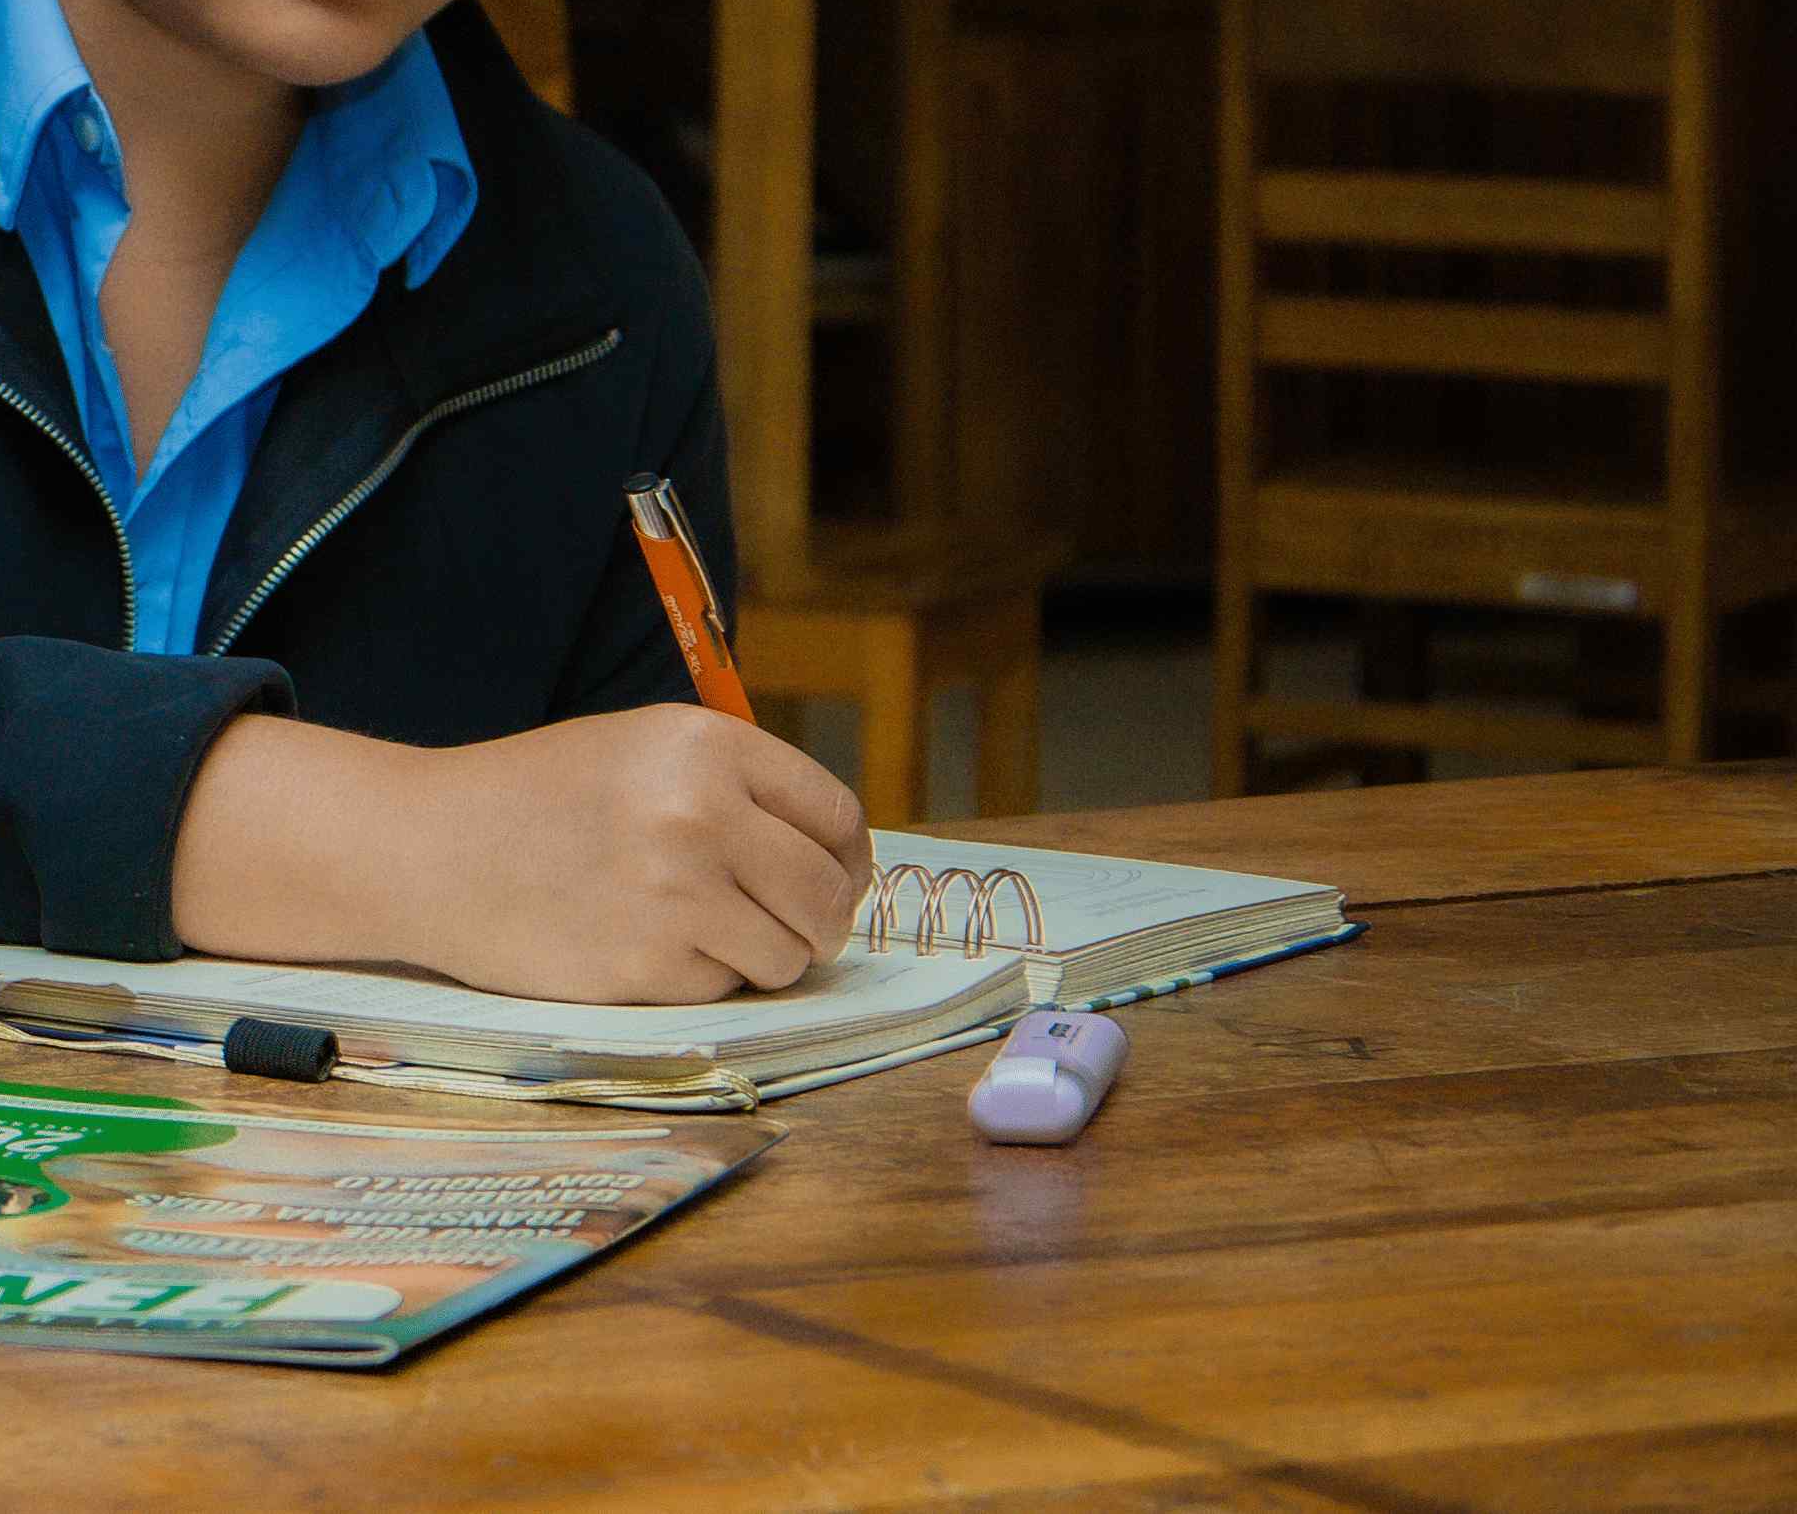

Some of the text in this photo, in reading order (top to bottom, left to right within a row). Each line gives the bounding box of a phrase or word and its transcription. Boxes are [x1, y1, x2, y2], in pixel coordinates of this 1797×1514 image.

[333, 1173, 646, 1192] CON ORGULLO
[123, 1193, 588, 1228] TRANSFORMA VIDAS
